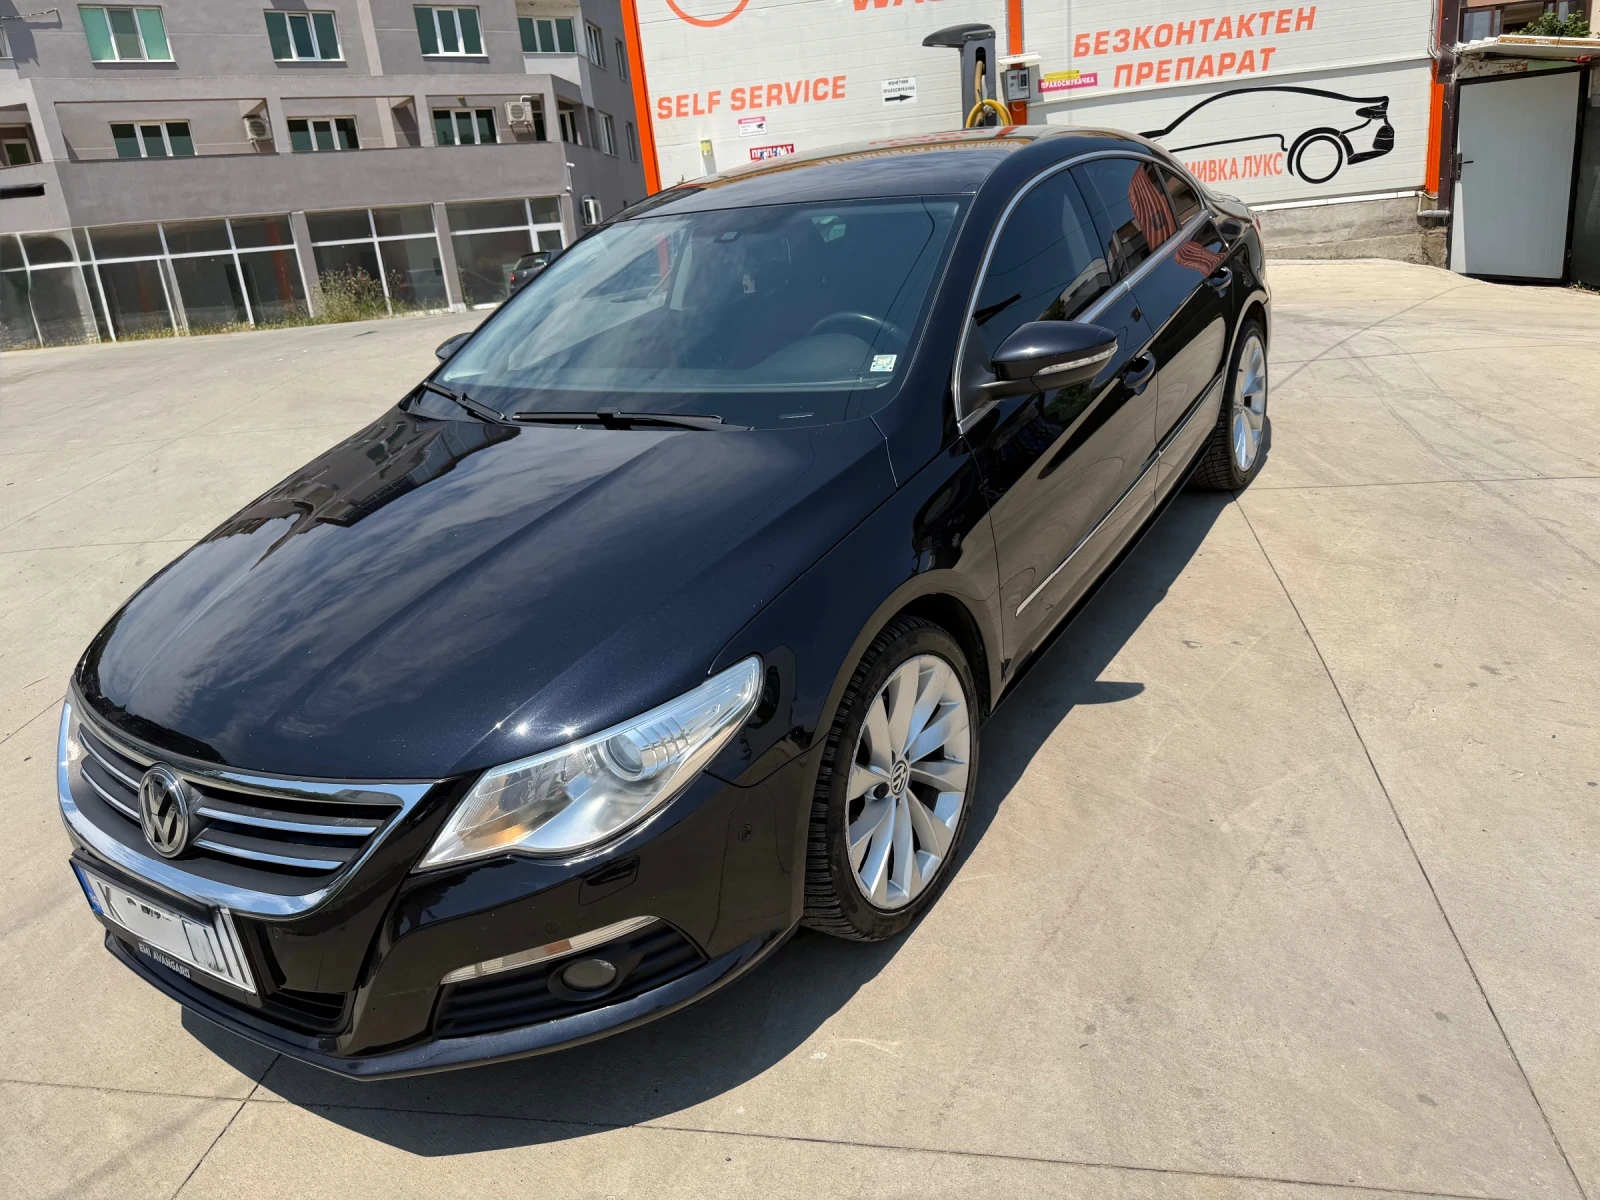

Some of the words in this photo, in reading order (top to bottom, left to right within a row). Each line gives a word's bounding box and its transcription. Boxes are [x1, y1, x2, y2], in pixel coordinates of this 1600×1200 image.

[1073, 6, 1316, 57] БЕЗКОНТАКТЕН
[1113, 47, 1276, 88] ПРЕПАРАТ
[657, 90, 721, 120] SELF
[730, 75, 846, 111] SERVICE
[1242, 152, 1282, 179] ЛУКС
